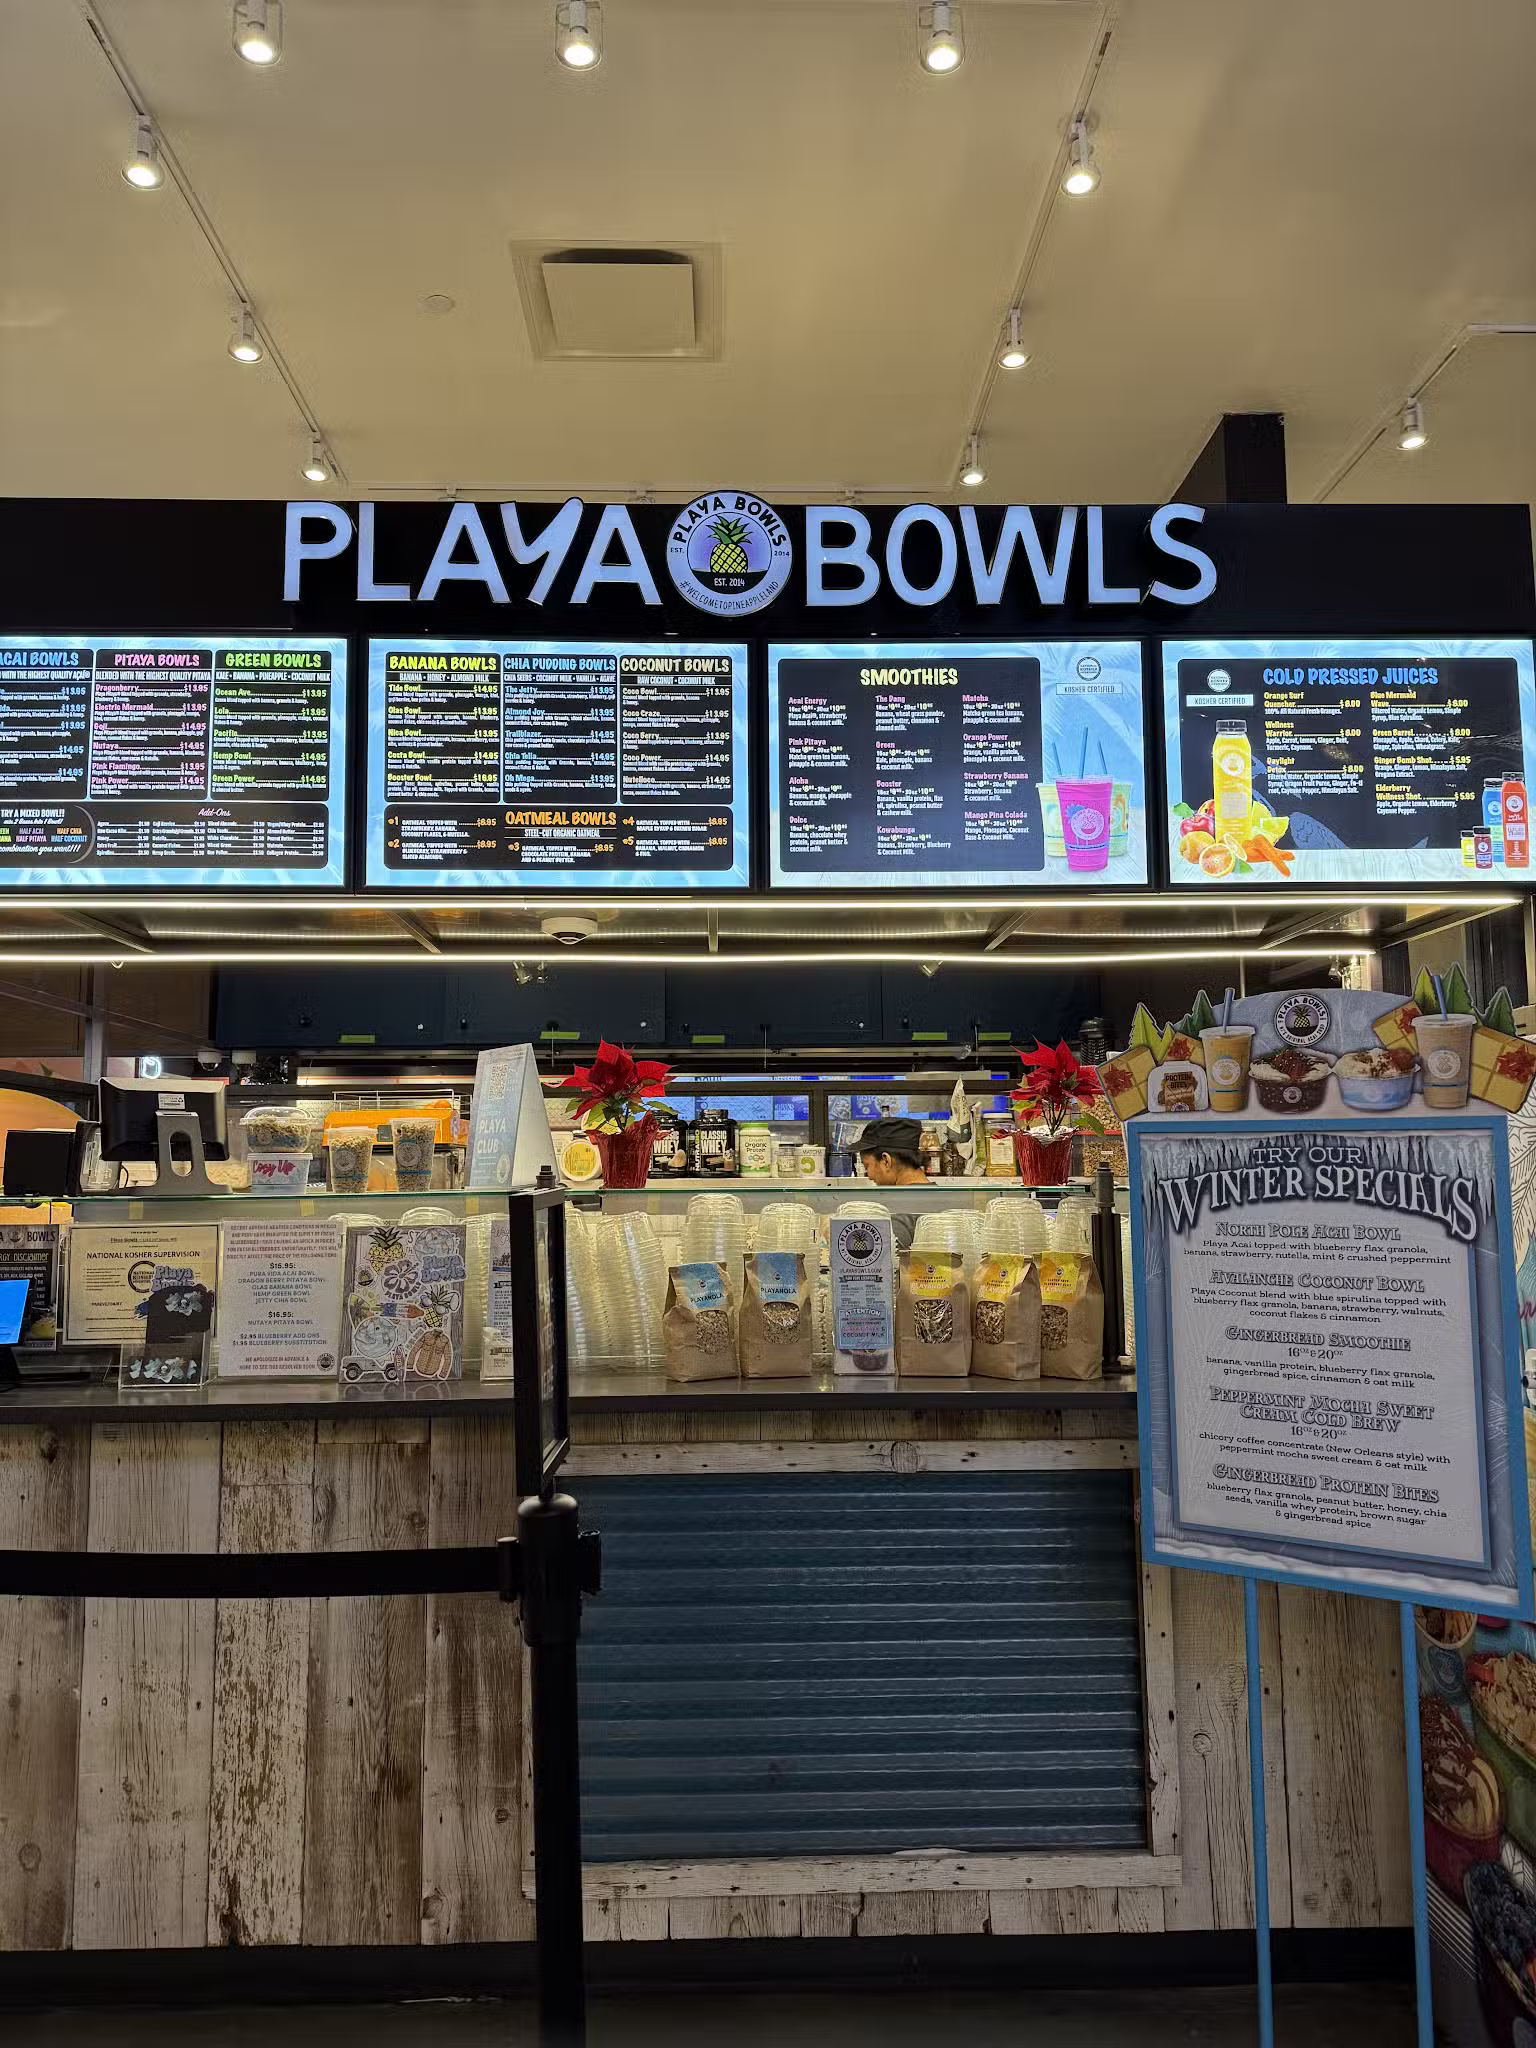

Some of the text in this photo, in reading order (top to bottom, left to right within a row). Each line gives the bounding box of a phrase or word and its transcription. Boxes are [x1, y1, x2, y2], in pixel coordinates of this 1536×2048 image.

[673, 496, 786, 546] PLAYA BOWLS
[284, 497, 1219, 608] PLAYA BOWLS
[714, 578, 745, 586] EST. 2014
[680, 581, 778, 610] #WELCOMETOPINEAPPLELAND
[30, 652, 79, 666] BOWLS
[115, 654, 200, 666] PITAYA BOWLS
[226, 653, 321, 667] GREEN BOWLS
[389, 656, 496, 670] BANANA BOWLS
[504, 658, 615, 671] CHIA PUDDING BOWLS
[621, 659, 729, 673] COCONUT BOWLS
[860, 668, 958, 686] SMOOTHIES
[1263, 668, 1438, 685] COLD PRESSED JUICES
[1376, 784, 1411, 793] Elderberry
[505, 812, 616, 825] OATMEAL BOWLS
[1279, 998, 1326, 1019] PLAYA BOWLS
[479, 1119, 506, 1134] PLAYA
[701, 1130, 727, 1139] CLASSIC
[477, 1140, 499, 1154] CLUB
[654, 1140, 679, 1154] WHEY
[701, 1140, 727, 1154] WHEY
[1253, 1147, 1363, 1164] TRY OUR
[1159, 1165, 1477, 1240] WINTER SPECIALS
[27, 1231, 56, 1242] BOWLS
[841, 1223, 879, 1242] PLAYA BOWLS
[1216, 1222, 1401, 1240] NORTH POLE ACAI BOWL
[87, 1251, 122, 1259] NATIONAL
[1203, 1240, 1228, 1248] Playa
[1255, 1242, 1286, 1250] topped
[1314, 1243, 1361, 1253] blueberry
[1387, 1246, 1428, 1254] granola,
[1221, 1250, 1273, 1260] strawberry,
[1276, 1252, 1310, 1260] nutella,
[1390, 1256, 1451, 1264] peppermint
[1209, 1269, 1424, 1293] AVALANCHE COCONUT BOWL
[690, 1293, 724, 1303] PLAYANOLA
[1191, 1287, 1446, 1306] Playa Coconut blend with blue spirulina topped with
[1193, 1297, 1237, 1307] blueberry
[1240, 1299, 1258, 1307] flax
[1261, 1301, 1299, 1310] granola,
[1301, 1302, 1340, 1312] banana,
[1342, 1305, 1399, 1315] strawberry,
[1290, 1310, 1318, 1319] flakes
[1329, 1314, 1381, 1322] cinnamon
[1225, 1326, 1411, 1351] GINGERBREAD SMOOTHIE
[1206, 1356, 1435, 1380] banana, vanilla protein, blueberry flax granola,
[1224, 1368, 1280, 1378] gingerbread
[1282, 1373, 1308, 1381] spice,
[1311, 1374, 1361, 1384] cinnamon
[1392, 1380, 1415, 1388] milk
[1210, 1385, 1434, 1419] PEPPERMINT MOCHA SWEET
[1240, 1404, 1401, 1432] CREAM COLD BREW
[1200, 1432, 1450, 1464] chicory coffee concentrate (New Orleans style) with
[1220, 1444, 1274, 1455] peppermint
[1277, 1450, 1309, 1459] mocha
[1311, 1454, 1339, 1462] sweet
[1342, 1458, 1372, 1466] cream
[1404, 1463, 1427, 1471] milk
[1213, 1463, 1439, 1503] GINGERBREAD PROTEIN BITES
[1207, 1482, 1447, 1518] blueberry flax granola, peanut butter, honey, chia
[1225, 1495, 1428, 1525] seeds, vanilla whey protein, brown sugar
[1284, 1511, 1371, 1528] gingerbread spice
